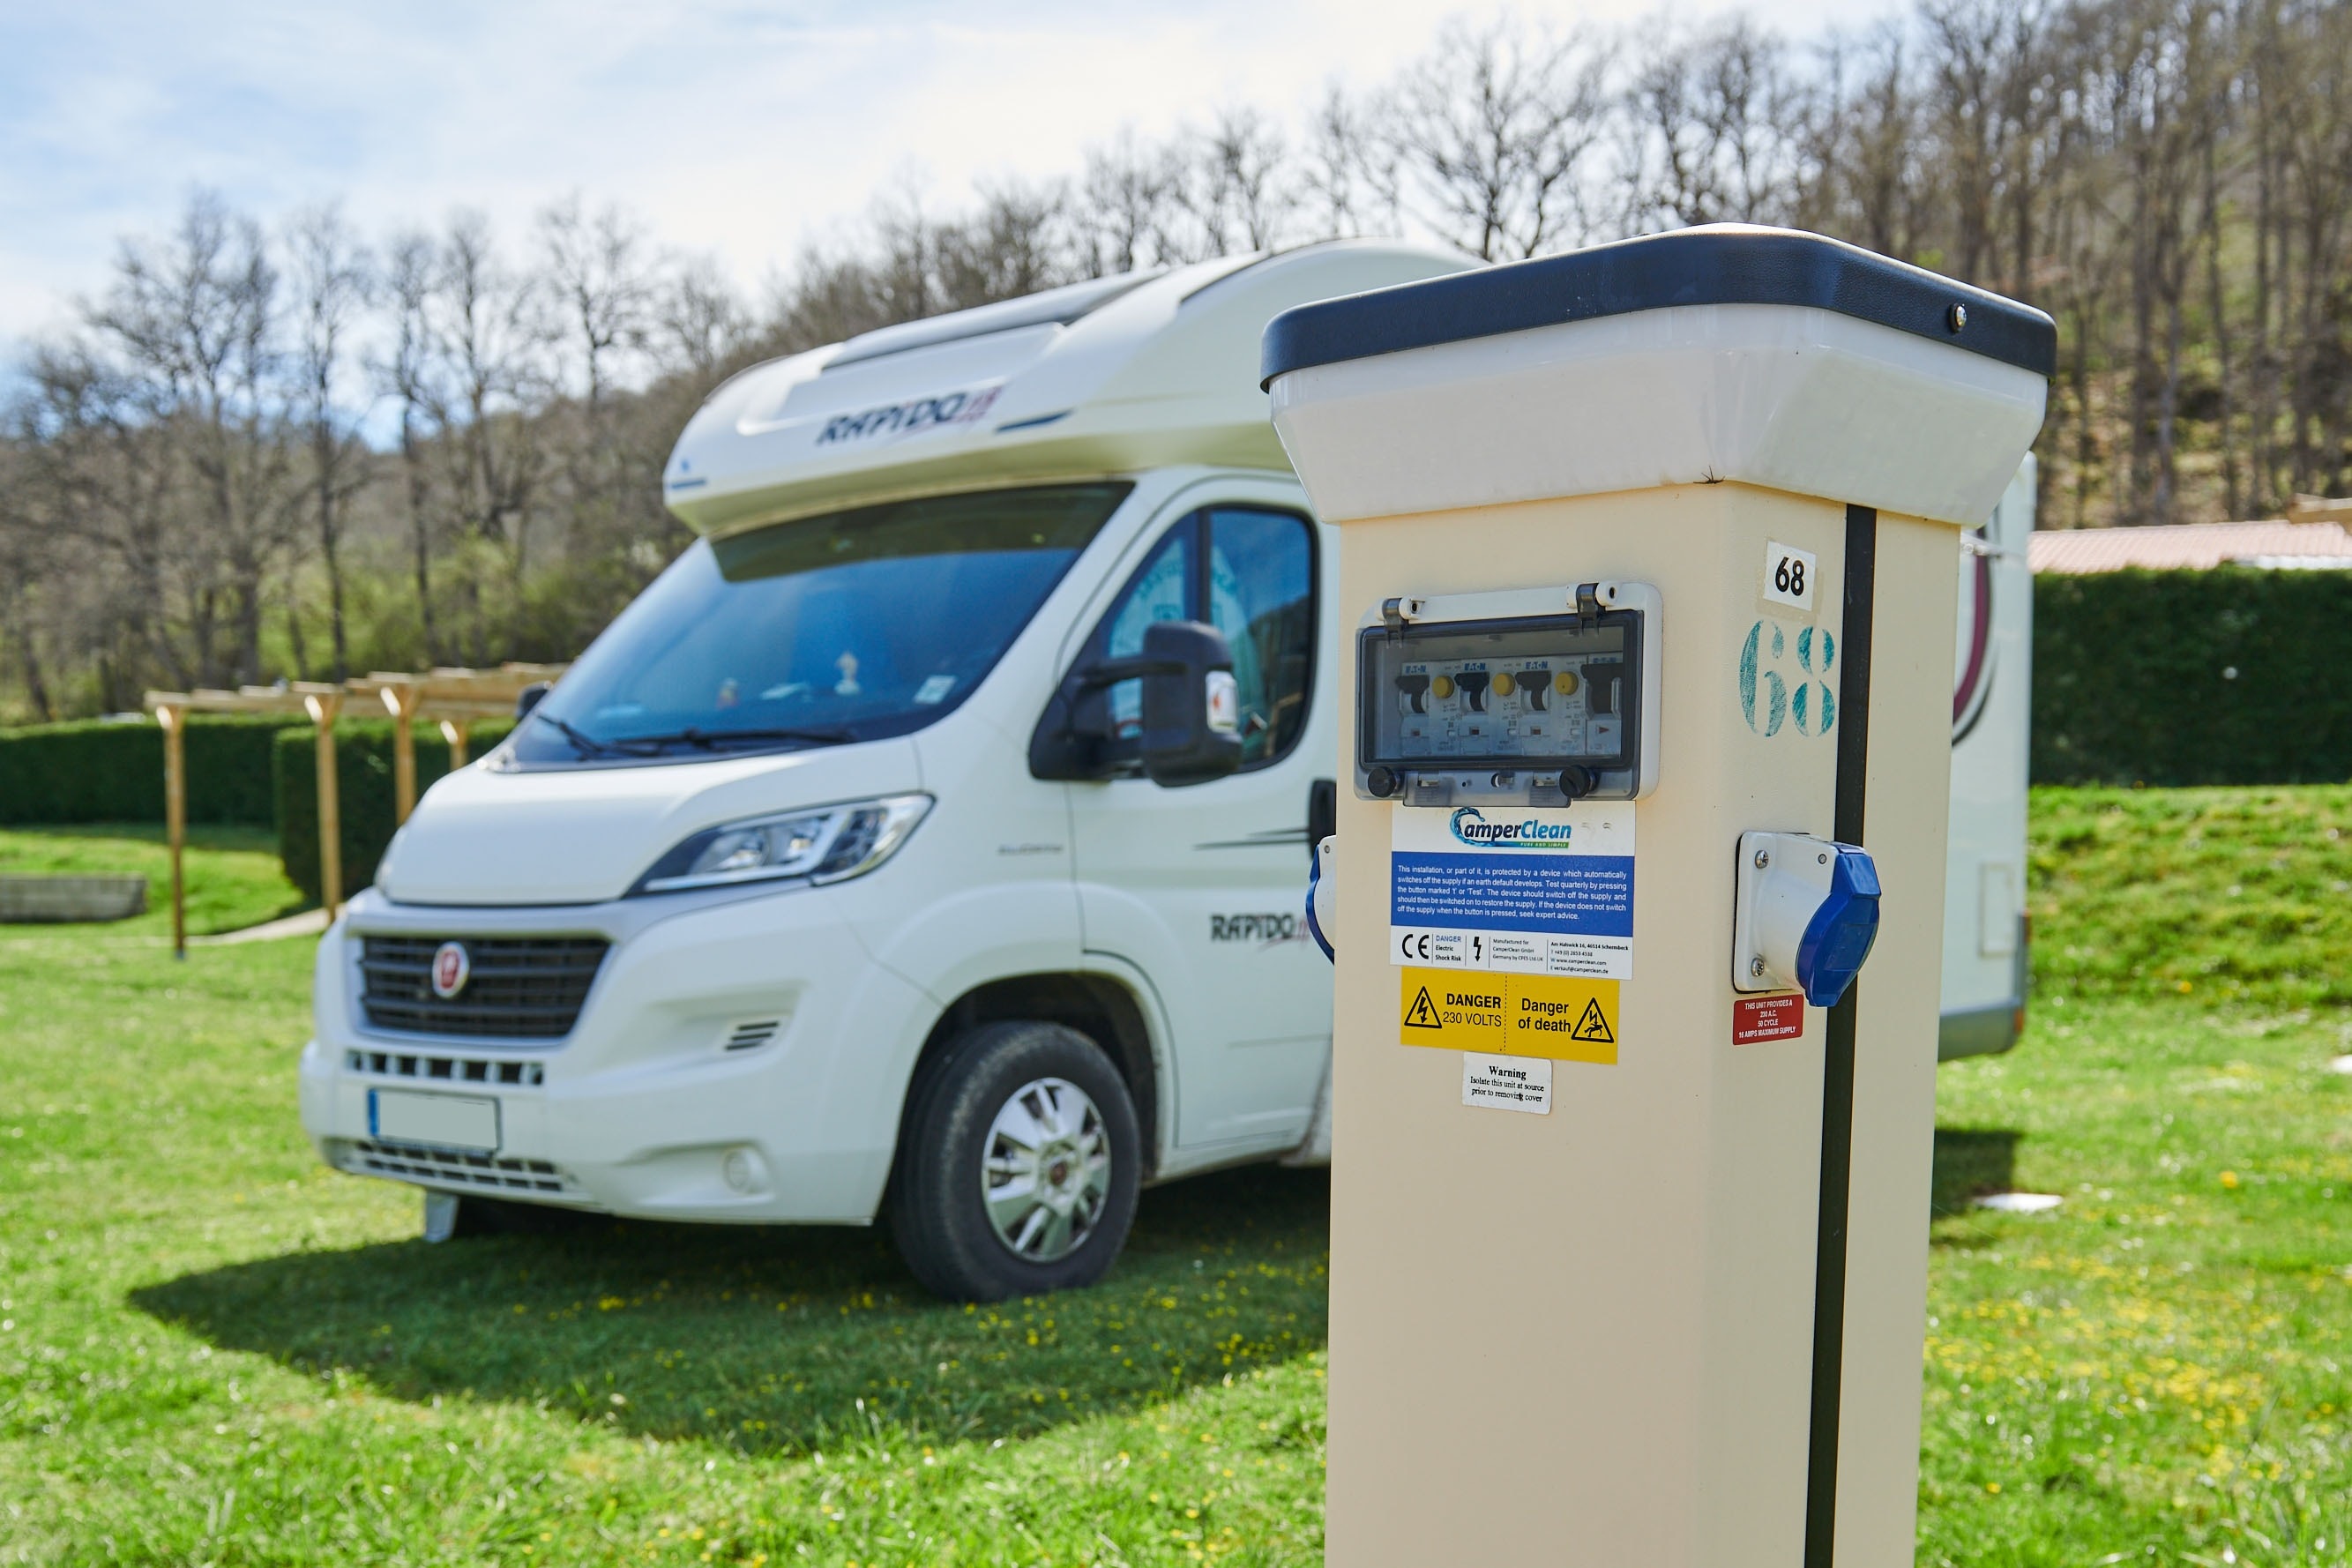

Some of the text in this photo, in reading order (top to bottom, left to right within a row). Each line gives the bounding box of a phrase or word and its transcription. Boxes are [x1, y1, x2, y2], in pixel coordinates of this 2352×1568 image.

[816, 392, 967, 446] RAPIDO
[1775, 556, 1804, 596] 68
[1739, 620, 1835, 737] 68
[1450, 807, 1572, 847] CamperClean
[1492, 868, 1521, 877] protected
[1584, 870, 1626, 880] automatically
[1560, 881, 1588, 890] quarterly
[1590, 892, 1612, 901] supply
[1416, 907, 1435, 915] supply
[1515, 900, 1537, 909] supply.
[1211, 914, 1293, 942] RAPIDO
[1446, 993, 1502, 1009] DANGER
[1521, 997, 1569, 1017] Danger
[1766, 999, 1789, 1008] PROVIDES
[1443, 1012, 1502, 1027] 230 VOLTS
[1518, 1016, 1572, 1033] of death
[1744, 1029, 1758, 1038] AMPS
[1758, 1027, 1780, 1036] MAXIMUM
[1779, 1026, 1796, 1034] SUPPLY
[1489, 1065, 1527, 1081] Warning
[1470, 1076, 1490, 1086] Isolate
[1471, 1086, 1487, 1096] prior
[1495, 1091, 1524, 1101] removing
